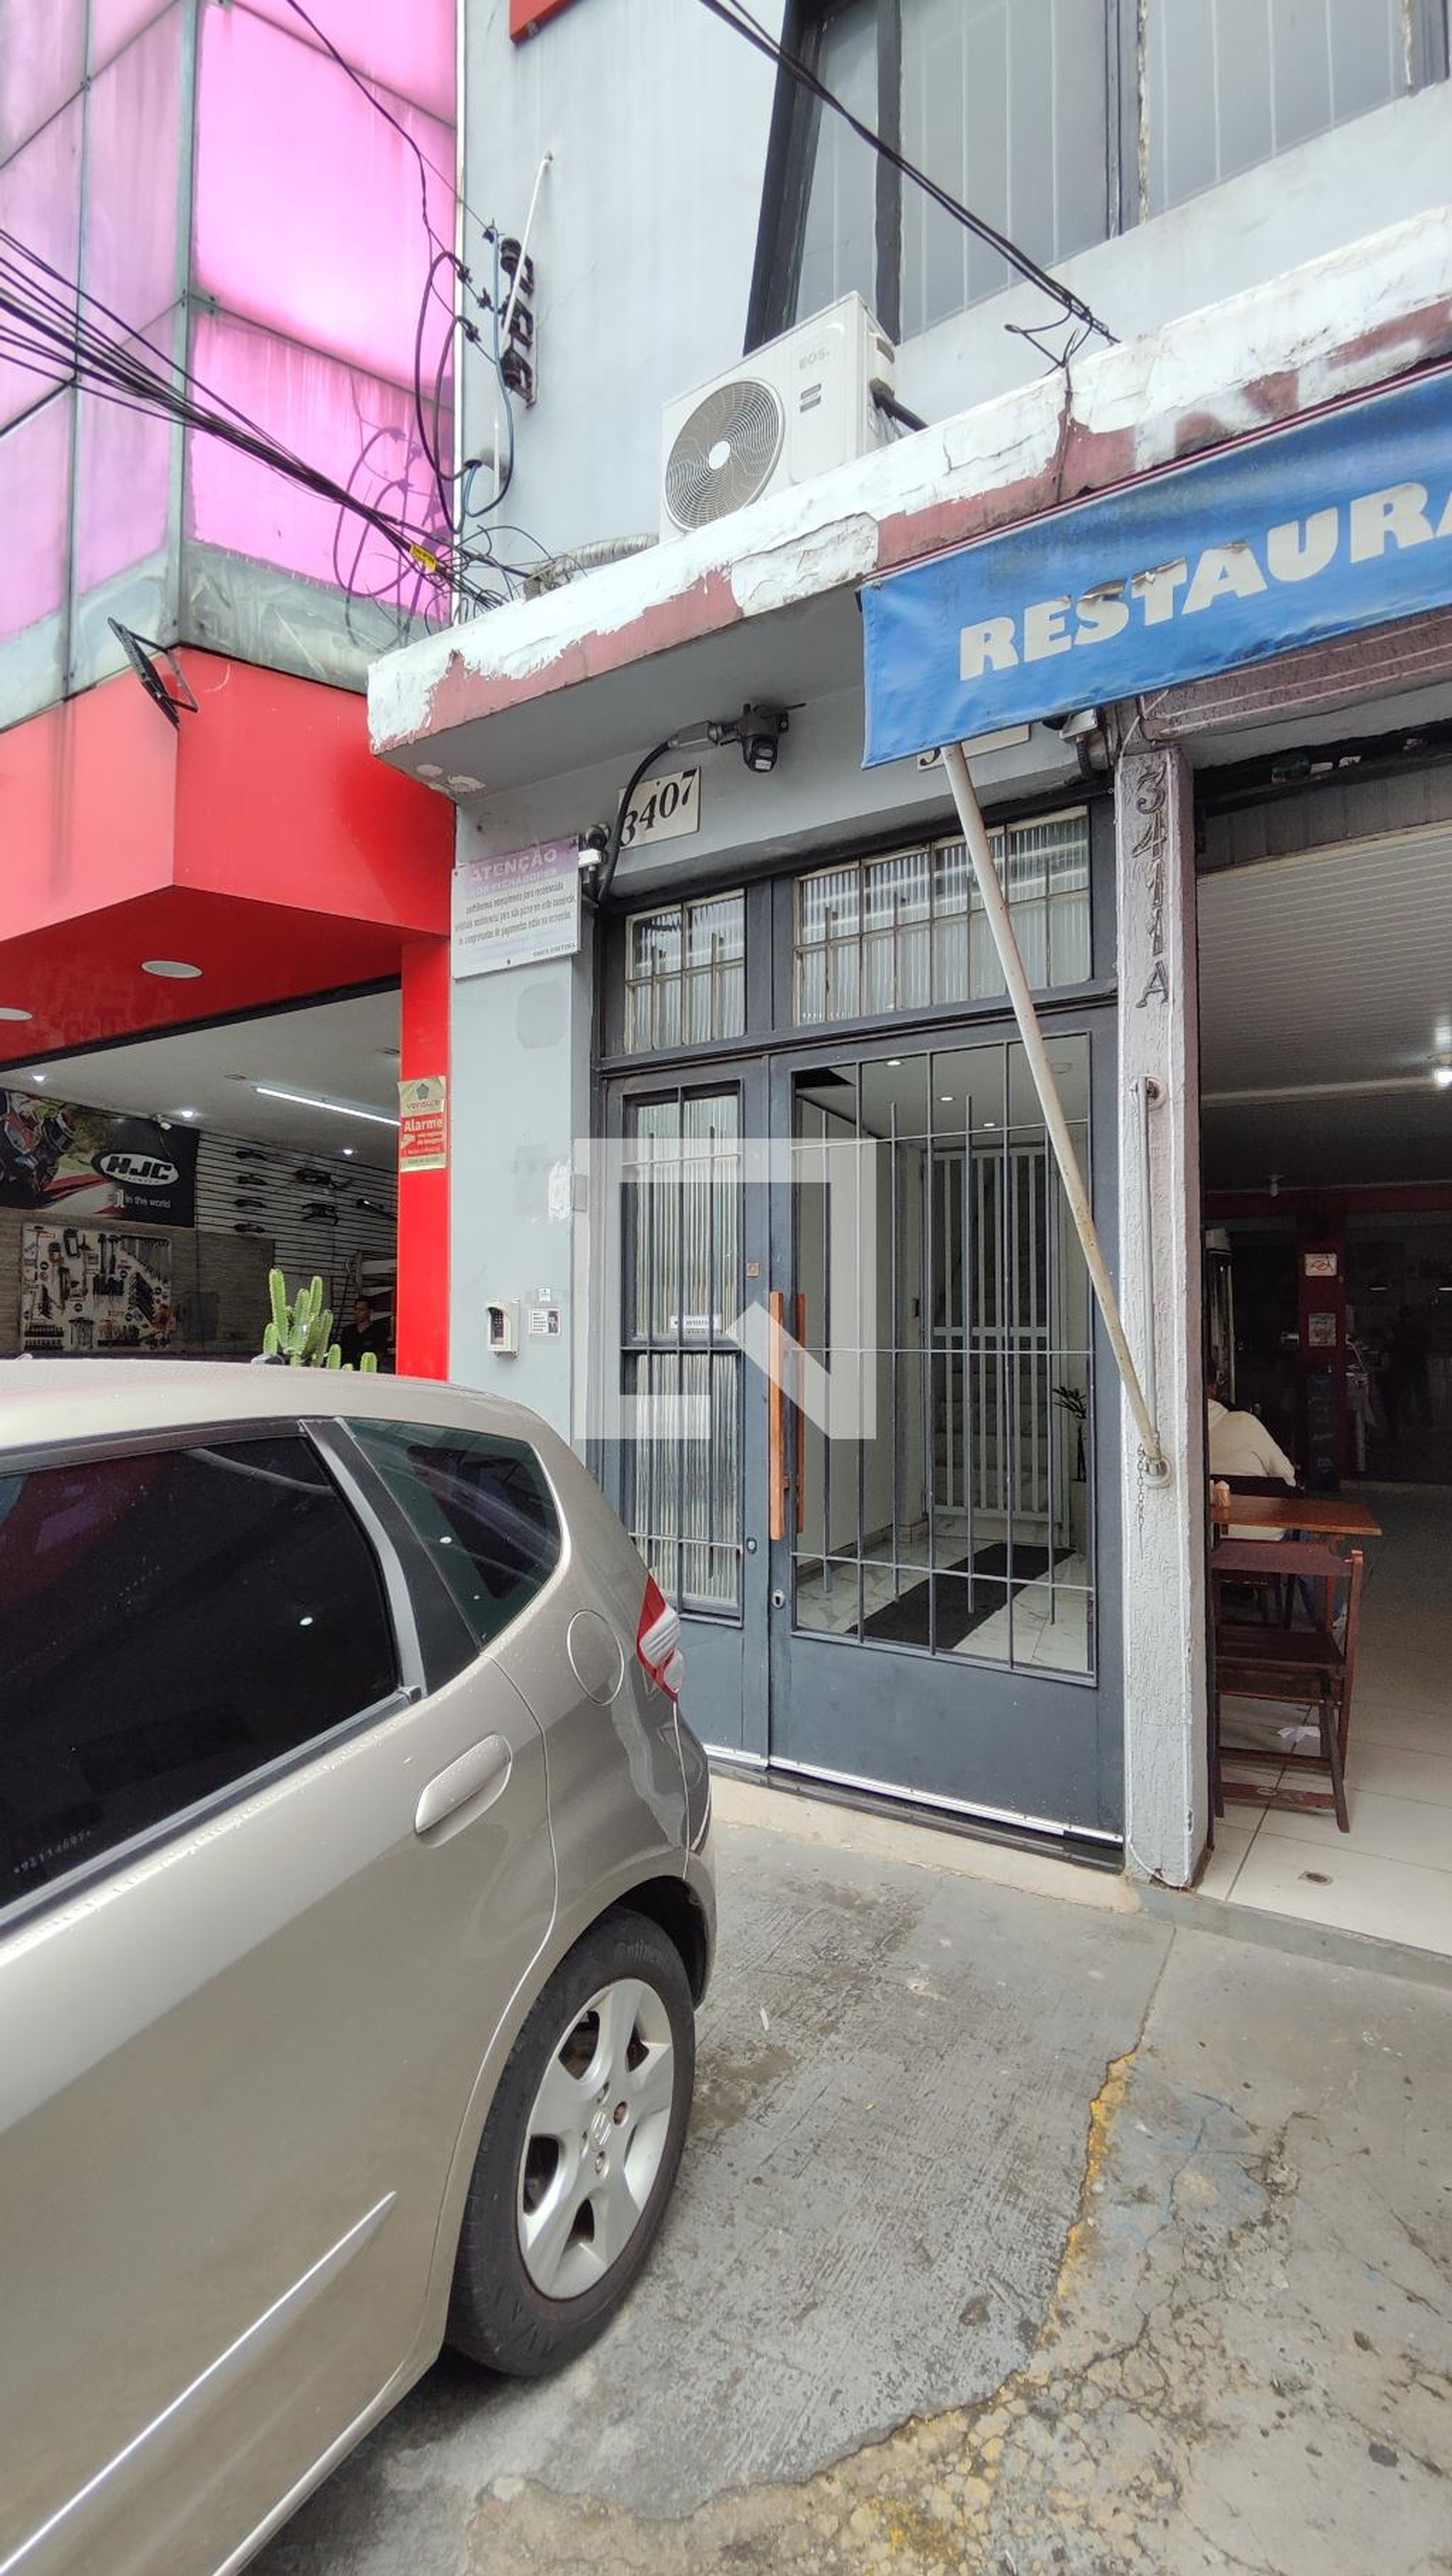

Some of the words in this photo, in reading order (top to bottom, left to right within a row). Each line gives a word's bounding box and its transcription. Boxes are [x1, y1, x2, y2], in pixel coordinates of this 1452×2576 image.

[960, 482, 1452, 680] RESTAUR
[620, 769, 697, 846] 3407
[470, 848, 557, 882] ATENÇÃO
[107, 1156, 172, 1180] HJC
[149, 1199, 171, 1209] world
